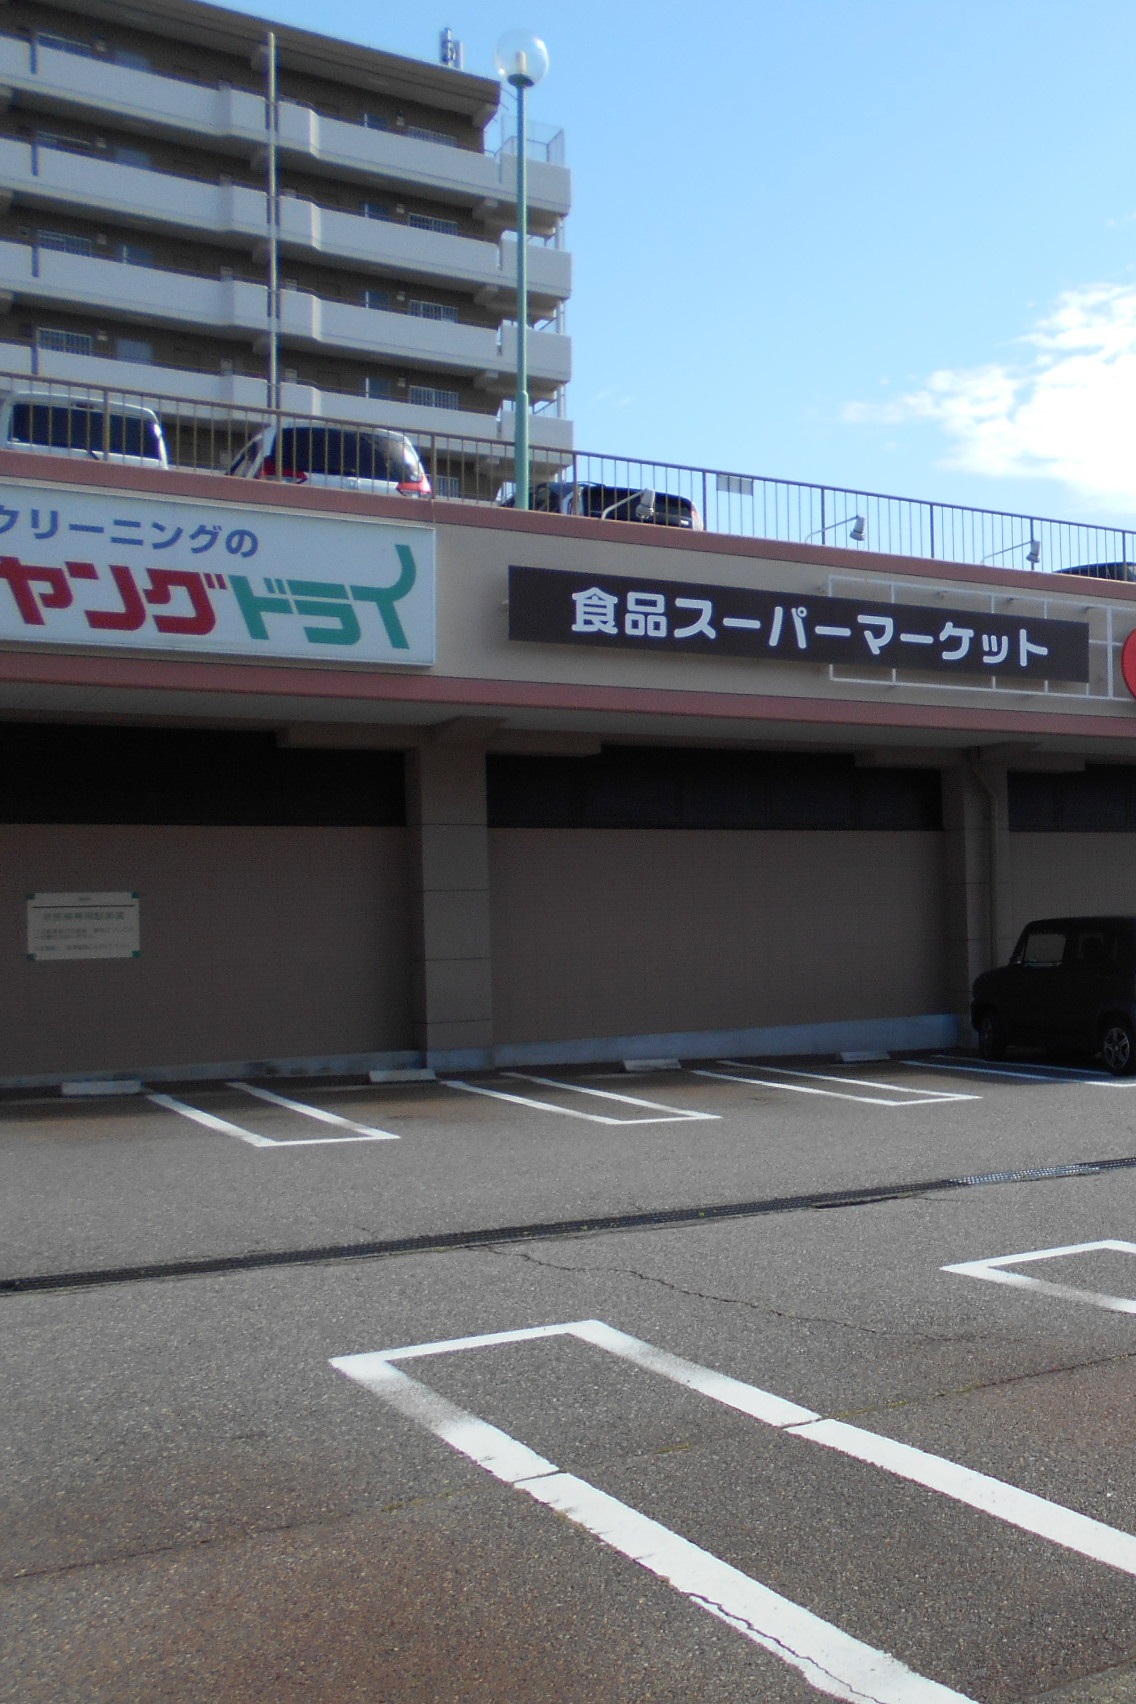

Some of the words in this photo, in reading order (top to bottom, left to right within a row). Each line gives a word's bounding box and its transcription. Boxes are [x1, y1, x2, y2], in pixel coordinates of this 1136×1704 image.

[571, 586, 1049, 667] 食品スーパーマーケット
